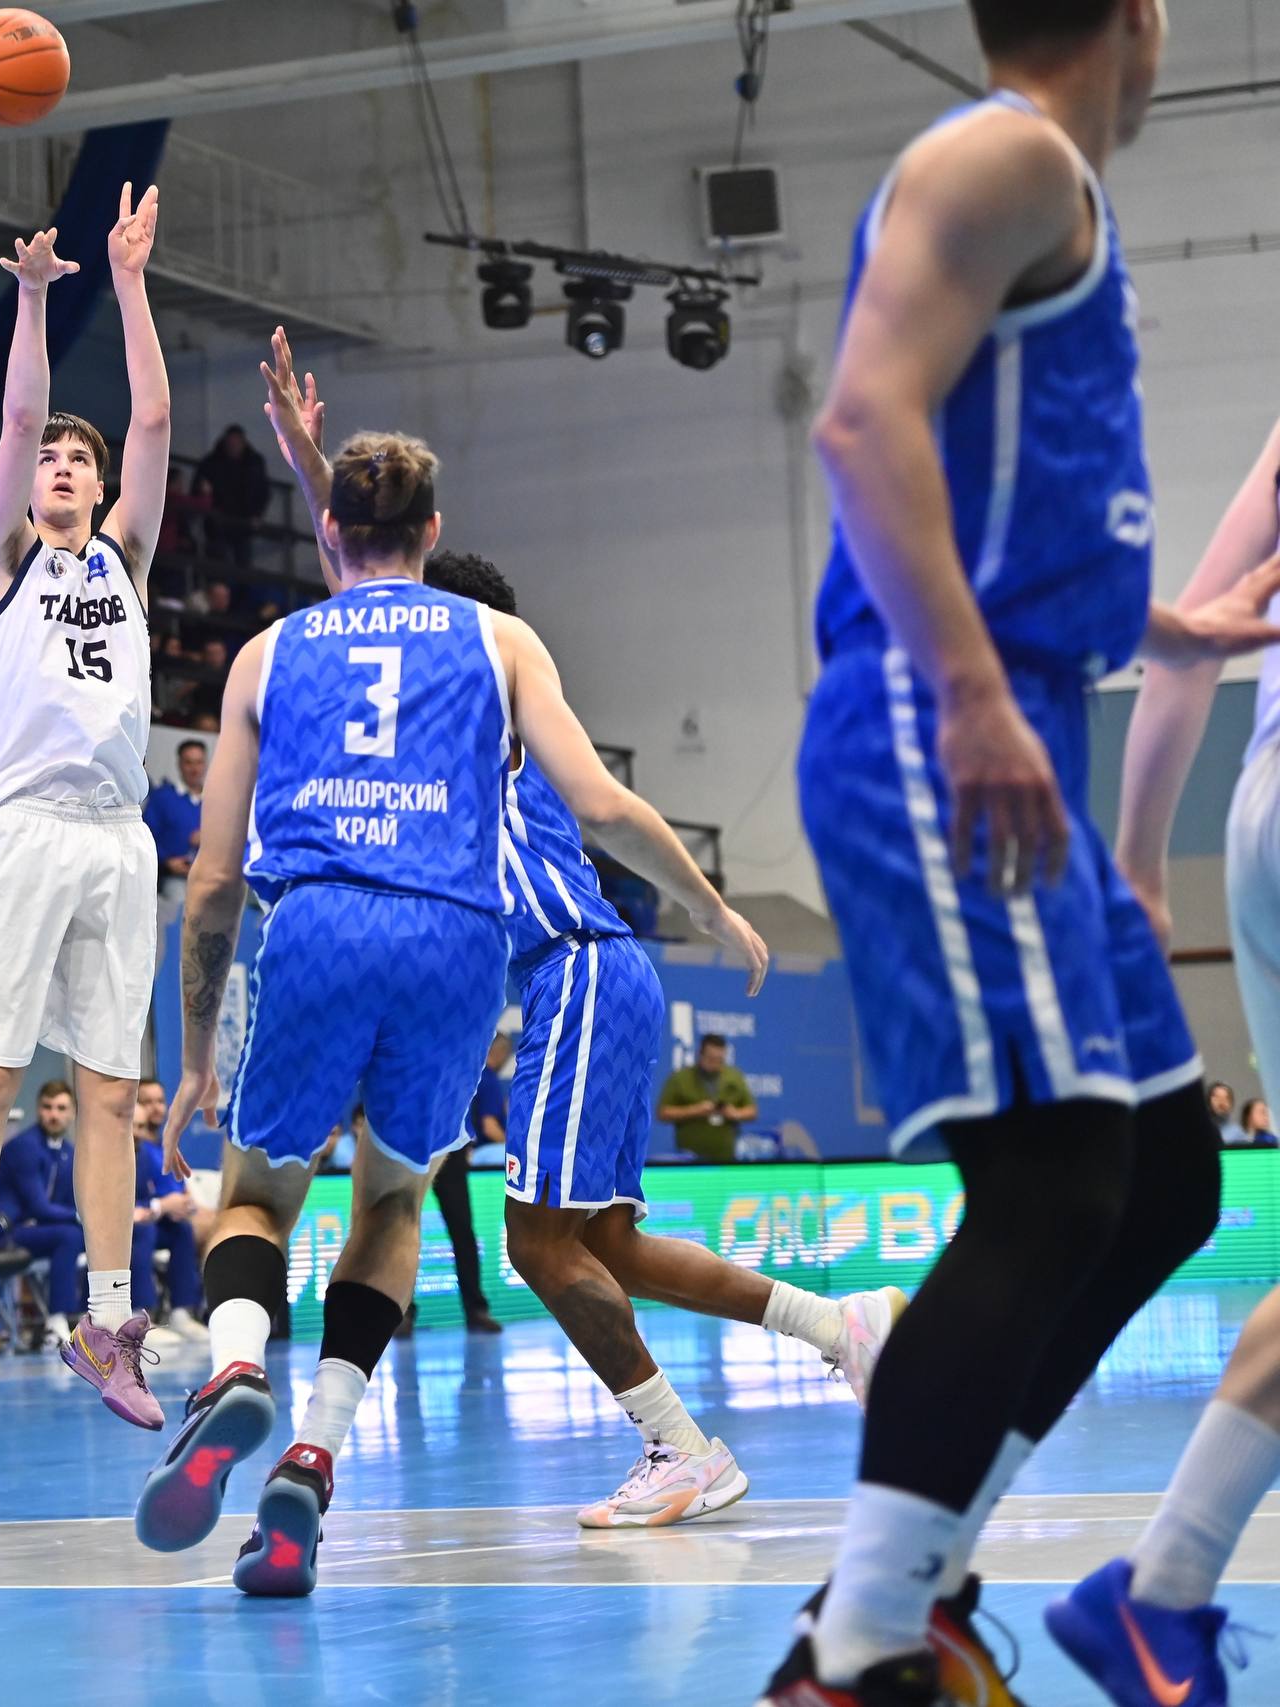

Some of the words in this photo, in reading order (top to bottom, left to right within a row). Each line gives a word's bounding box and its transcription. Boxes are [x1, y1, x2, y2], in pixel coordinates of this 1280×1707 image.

[304, 605, 451, 639] ЗАХАРОВ
[65, 637, 113, 683] 15
[344, 646, 402, 758] 3
[335, 813, 398, 846] КРАЙ
